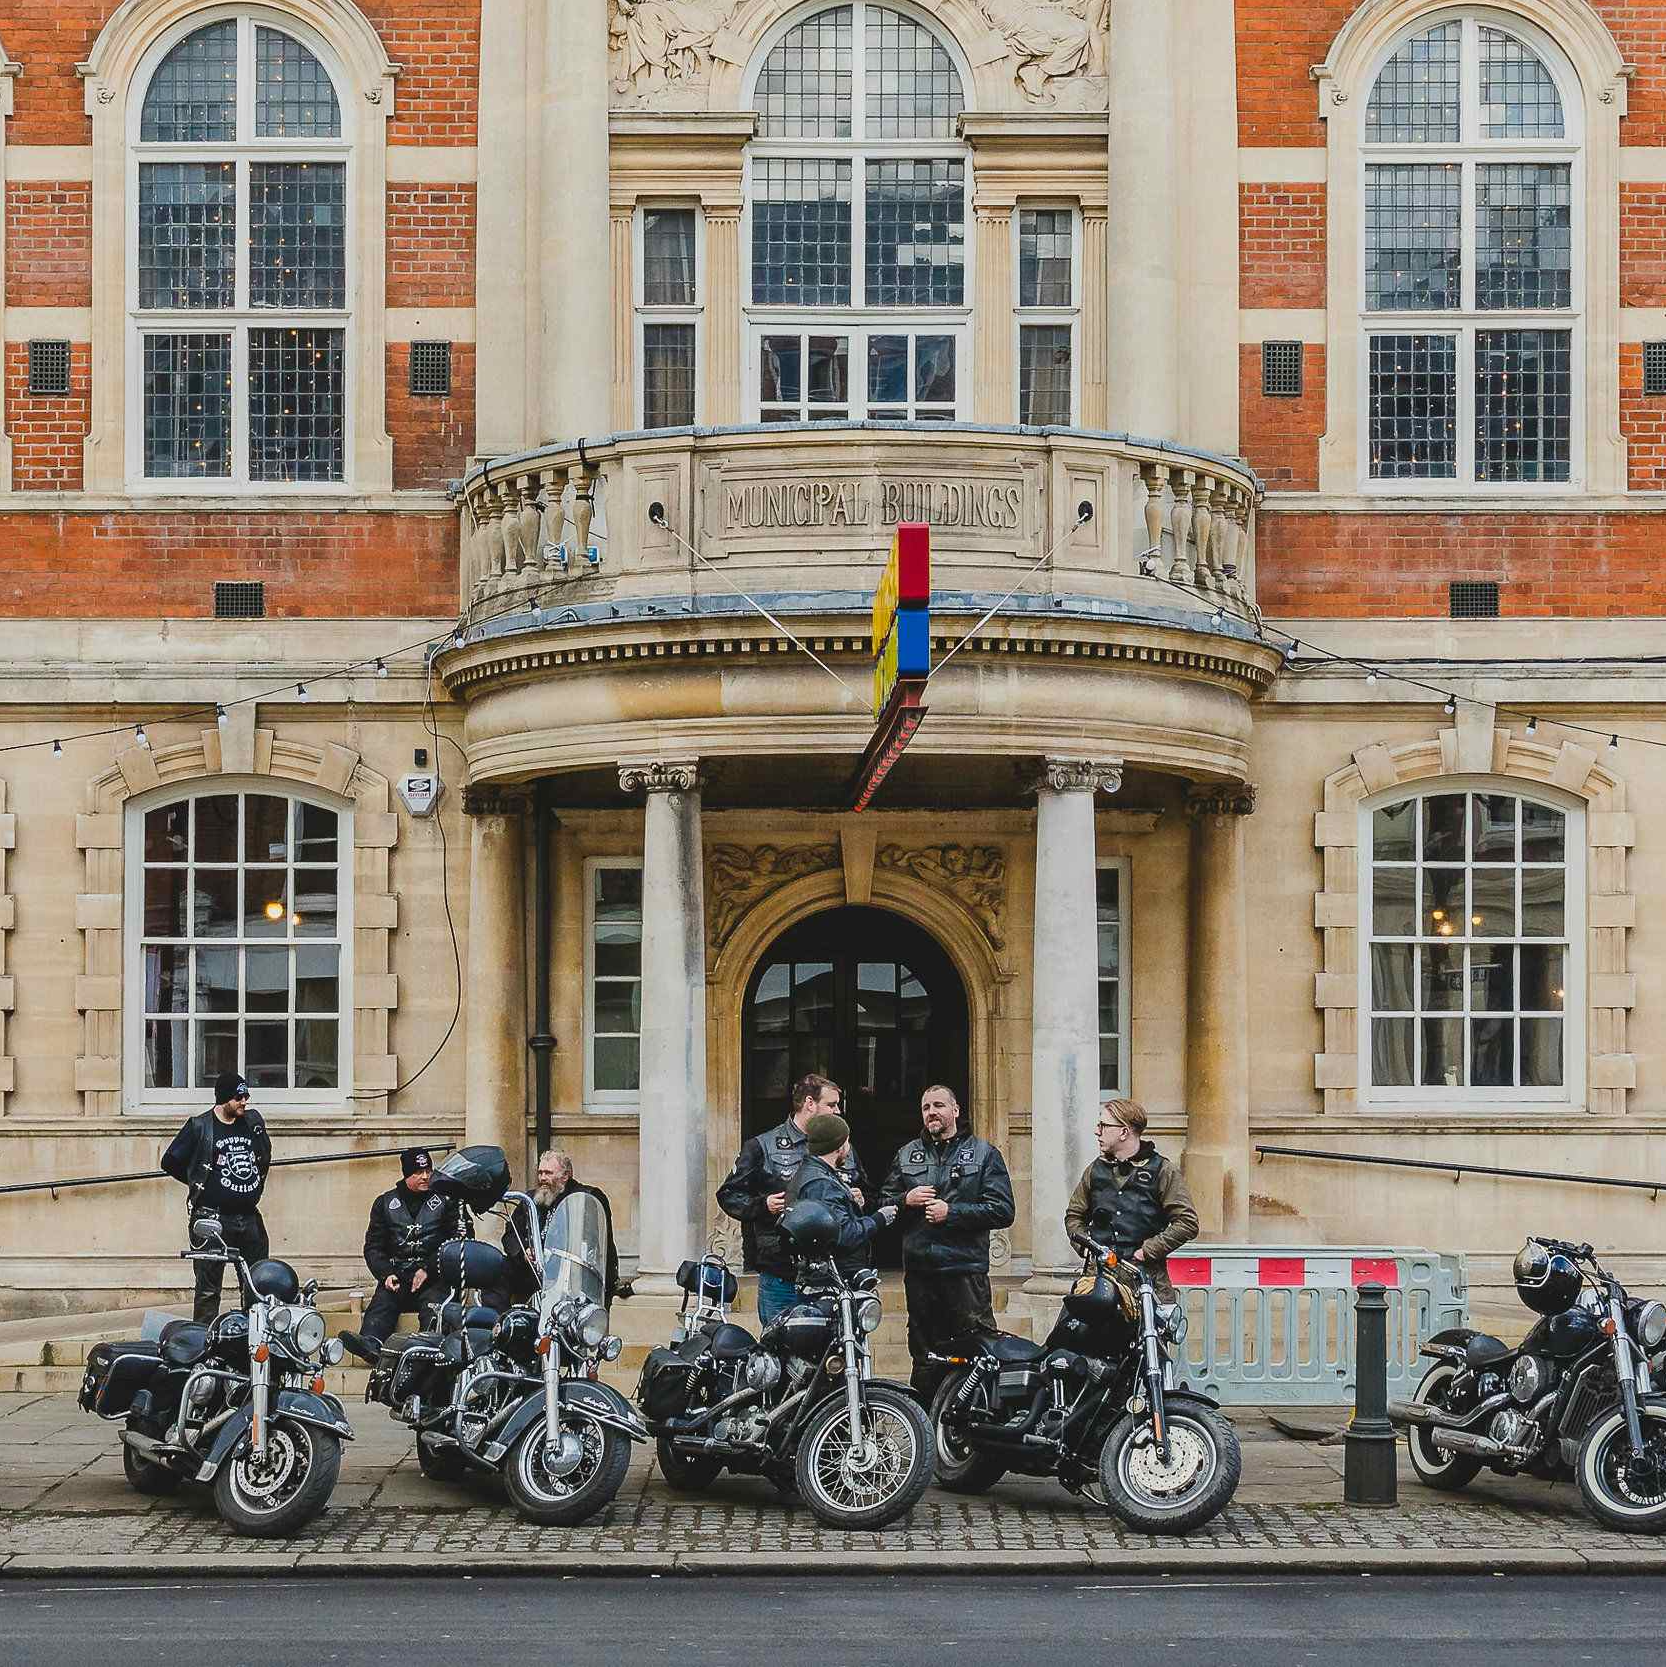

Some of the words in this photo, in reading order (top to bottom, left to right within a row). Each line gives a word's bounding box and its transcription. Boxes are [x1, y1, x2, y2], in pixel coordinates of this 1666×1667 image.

[726, 482, 869, 528] MUNICIPAL
[883, 483, 1019, 528] BUILDINGS
[216, 1136, 252, 1149] Support
